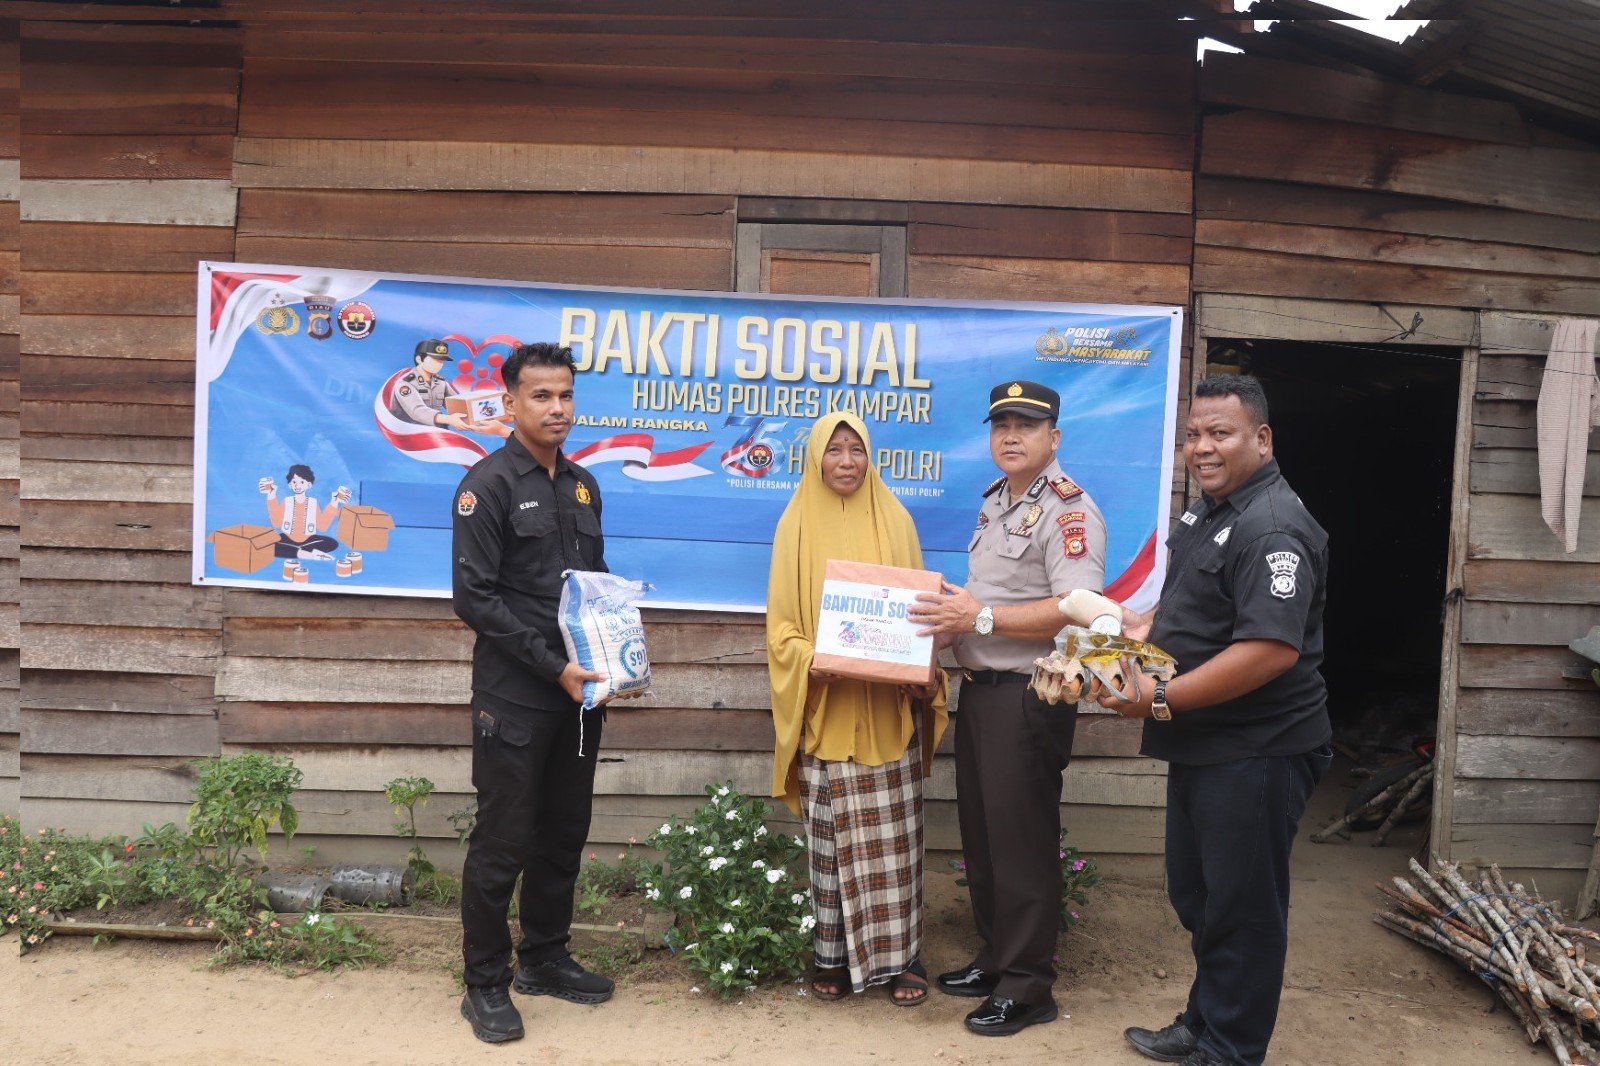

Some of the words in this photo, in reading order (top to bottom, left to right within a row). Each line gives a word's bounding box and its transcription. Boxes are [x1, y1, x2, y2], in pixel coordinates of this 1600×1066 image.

[1064, 327, 1111, 339] POLISI
[559, 307, 720, 378] BAKTI
[734, 316, 931, 389] SOSIAL
[1073, 338, 1114, 347] BERSAMA
[1068, 347, 1152, 360] MASYARAKAT
[632, 379, 722, 414] HUMAS
[727, 383, 820, 418] POLRES
[827, 388, 931, 424] KAMPAR
[573, 415, 627, 428] ALAM
[631, 417, 708, 432] RANGKA
[877, 448, 942, 482] POLRI
[756, 480, 792, 490] BERSAMA
[822, 593, 884, 617] BANTUAN
